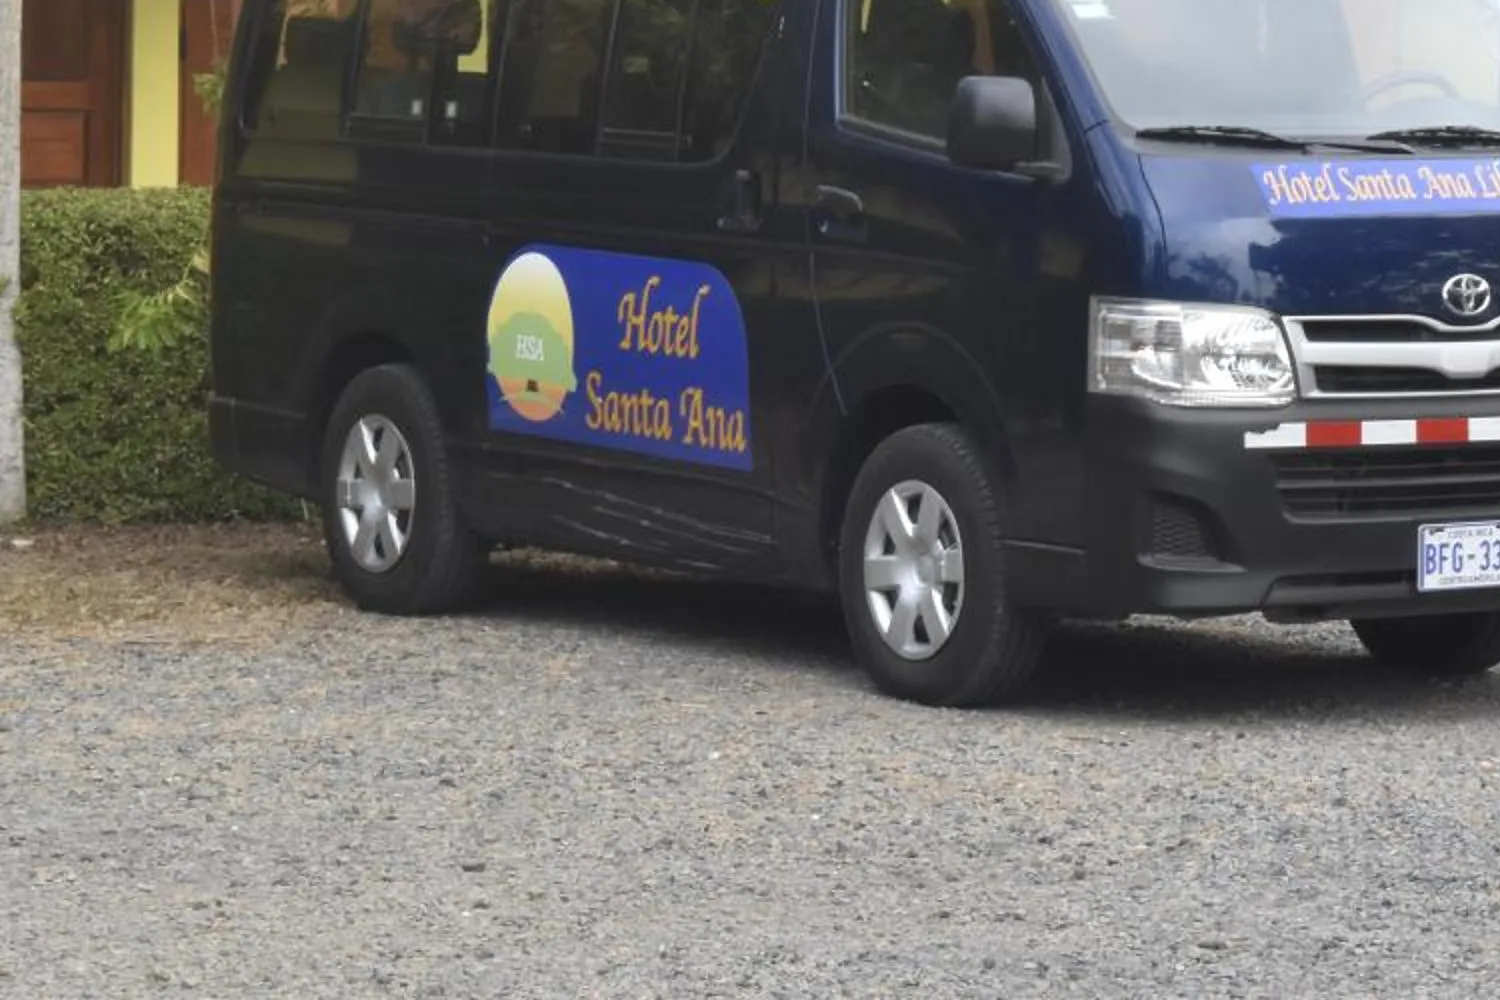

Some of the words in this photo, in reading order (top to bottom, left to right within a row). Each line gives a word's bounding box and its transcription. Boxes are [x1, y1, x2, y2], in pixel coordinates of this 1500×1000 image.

[1263, 163, 1340, 205] Hotel
[1337, 167, 1417, 201] Santa
[1417, 165, 1476, 200] Ana
[515, 333, 545, 361] HSA
[617, 275, 710, 359] Hotel
[584, 369, 673, 440] Santa
[679, 386, 746, 453] Ana
